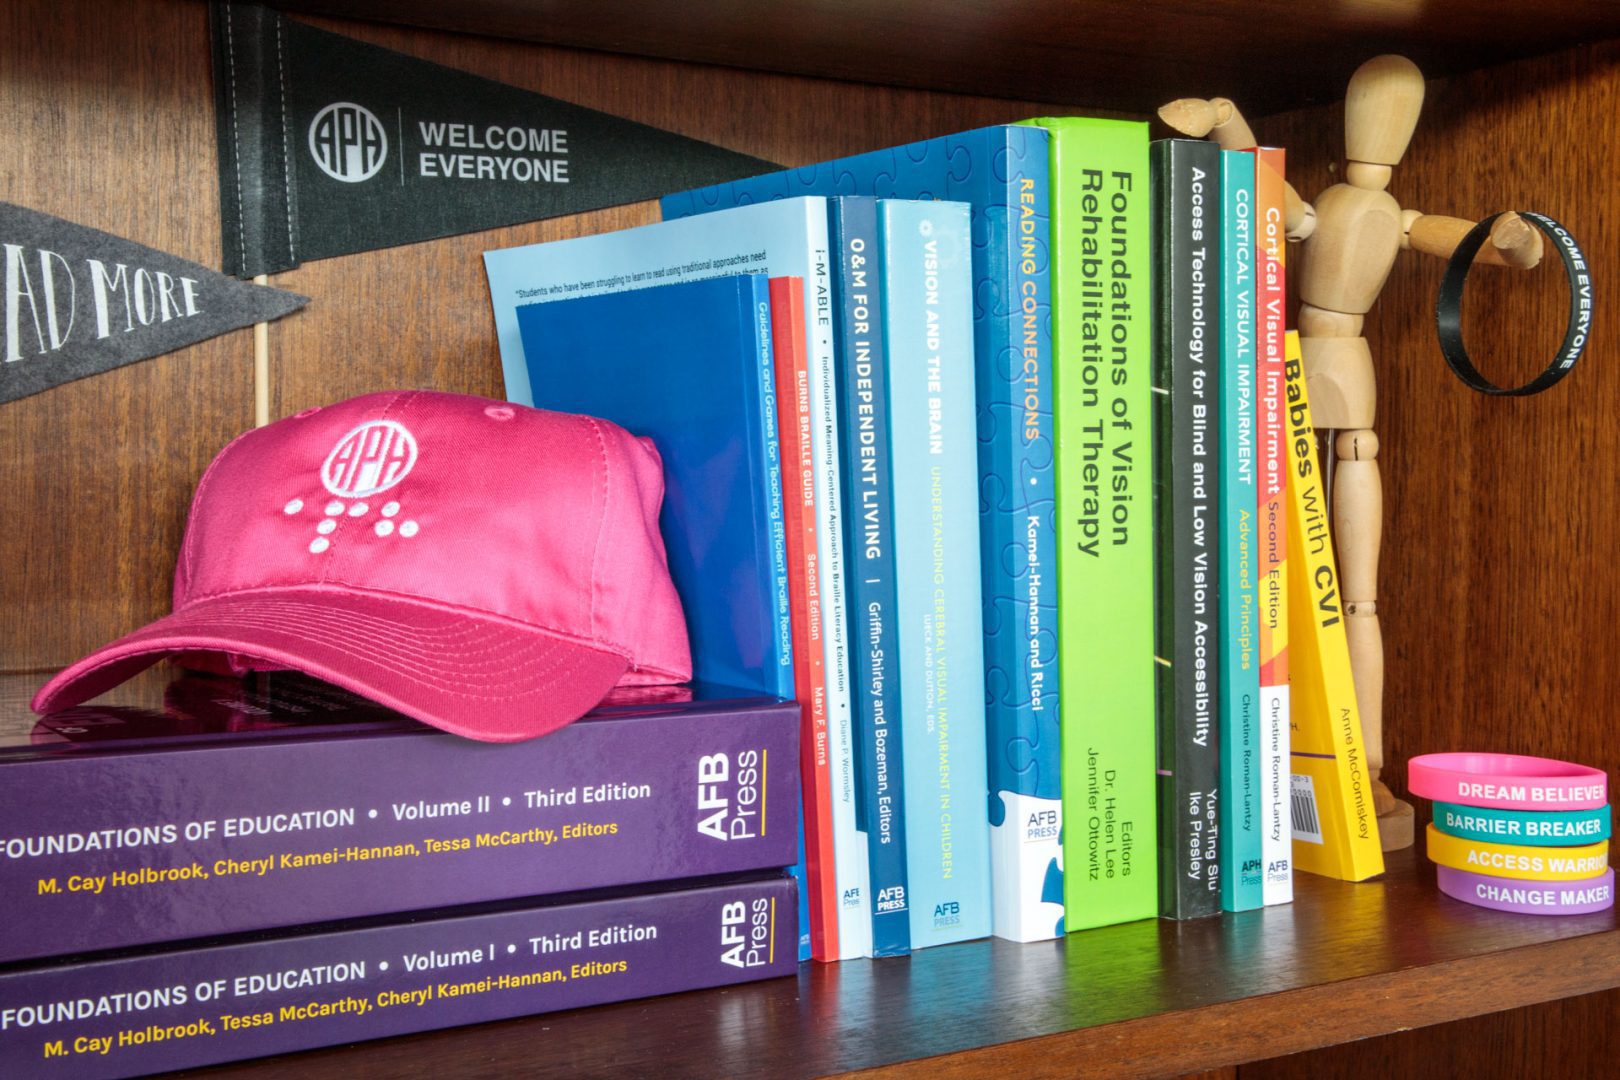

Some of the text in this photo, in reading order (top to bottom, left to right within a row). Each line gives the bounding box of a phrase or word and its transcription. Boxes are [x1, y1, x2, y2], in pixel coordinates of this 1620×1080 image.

[308, 102, 388, 183] APH
[419, 121, 569, 154] WELCOME
[419, 153, 570, 183] EVERYONE
[3, 243, 204, 363] AD MORE
[596, 275, 625, 288] struggling
[713, 253, 749, 269] approaches
[750, 249, 767, 261] need
[1077, 168, 1103, 558] Rehabilitation Therapy
[1111, 170, 1132, 546] Foundations of Vision
[1559, 274, 1591, 369] EVERYONE
[321, 419, 418, 498] APH
[1020, 178, 1044, 711] READING CONNECTIONS Kamei-Hannan and Ricci
[1189, 167, 1209, 747] Access Technology for Blind and Low Vision Accessibility
[1285, 359, 1313, 478] Babies
[758, 302, 792, 666] Guidelines and Games for Teaching Efficient Braille Reading
[816, 249, 846, 692] i-M-ABLE Individualized Meaning-Centered Approach to Braille Literacy Education
[1236, 189, 1253, 831] CORTICAL VISUAL IMPAIRMENT Advanced Principles Christine Roman-Lantzy
[797, 370, 827, 766] BURNS BRAILLE GUIDE Second Edition Mary Burns
[850, 238, 892, 844] O&M FOR INDEPENDENT LIVING Griffin-Shirley and Bozeman, Editors
[924, 240, 953, 879] VISION AND THE BRAIN UNDERSTANDING CEREBRAL VISUAL IMPAIRMENT IN CHILDREN
[1263, 207, 1282, 842] Cortical Visual Impairment Second Edition Christine Roman-Lantzy
[1314, 564, 1340, 628] CVI
[1340, 708, 1355, 745] Anne
[185, 820, 217, 841] OF
[223, 808, 355, 837] EDUCATION
[392, 800, 472, 821] Volume
[478, 796, 490, 813] II
[524, 787, 577, 809] Third
[582, 782, 651, 804] Edition
[697, 752, 729, 842] AFB
[730, 750, 758, 840] Press
[1027, 810, 1058, 826] AFB
[1027, 826, 1058, 838] PRESS
[1087, 748, 1101, 881] Jennifer Ottowitz
[1104, 770, 1117, 879] Dr. Helen Lee
[1347, 748, 1369, 839] McComiskey
[1446, 812, 1601, 836] BARRIER BREAKER
[1458, 782, 1604, 801] DREAM BELIEVER
[38, 821, 618, 895] M. Cay Holbrook, Cheryl Kamei-Hannan, Tessa McCarthy, Editors
[1121, 821, 1133, 877] Editors
[1187, 792, 1202, 880] Ike Presley
[1205, 789, 1219, 891] Yue-Ting Siu
[1268, 860, 1288, 872] AFB
[1467, 850, 1544, 872] ACCESS
[720, 900, 746, 969] AFB
[746, 898, 768, 967] Press
[877, 886, 905, 901] AFB
[877, 899, 906, 911] PRESS
[934, 901, 960, 917] AFB
[1476, 884, 1610, 905] CHANGE MAKER
[2, 986, 187, 1030] FOUNDATIONS
[194, 979, 227, 1002] OF
[234, 961, 365, 997] EDUCATION
[403, 949, 483, 972] Volume
[529, 932, 582, 955] Third
[589, 924, 657, 948] Edition
[44, 958, 628, 1058] M. Cay Holbrook, Tessa McCarthy, Cheryl Kamei-Hannan, Editors
